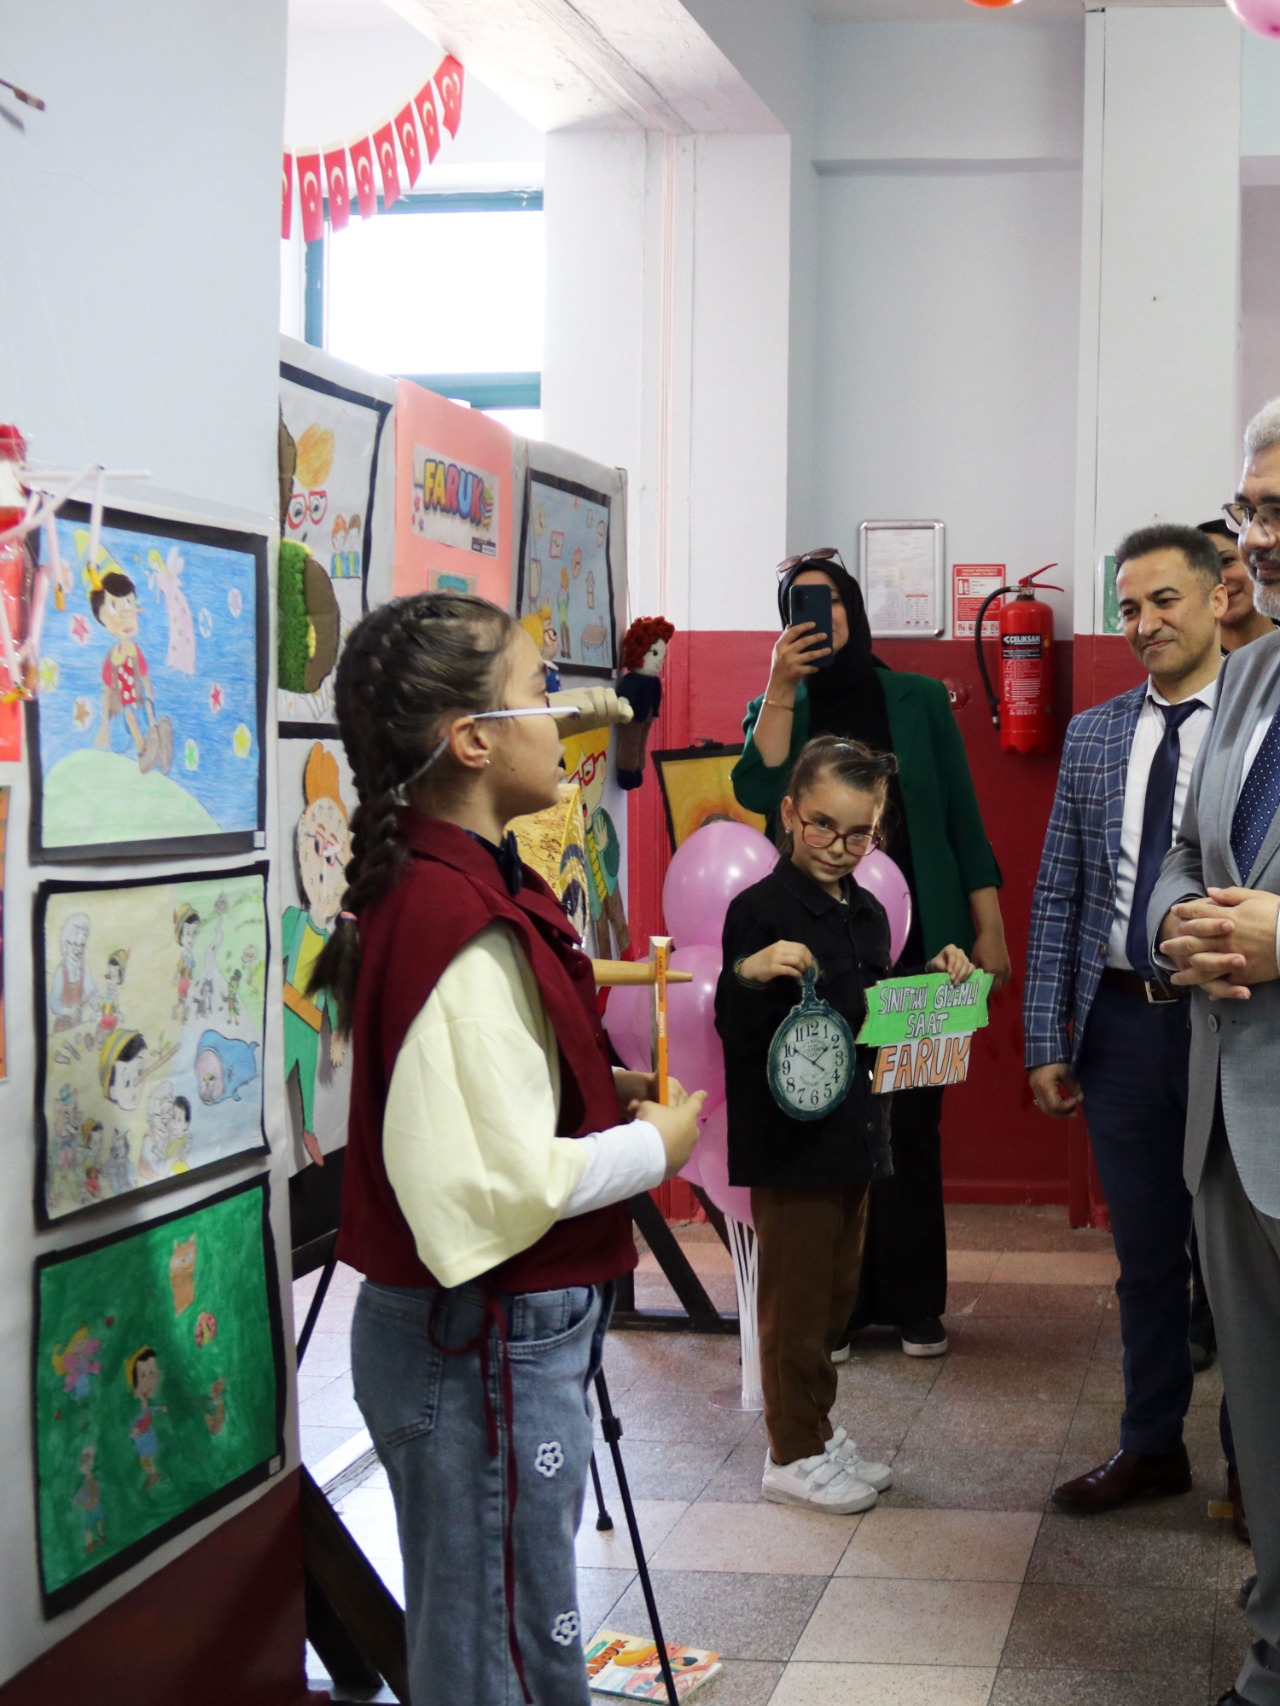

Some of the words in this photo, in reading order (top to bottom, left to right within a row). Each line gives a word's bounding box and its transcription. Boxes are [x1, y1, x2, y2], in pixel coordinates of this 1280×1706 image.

[424, 458, 484, 526] FARUK
[934, 978, 979, 1009] GİZEMLİ
[806, 1020, 819, 1037] 12
[823, 1023, 829, 1039] 1
[905, 1011, 949, 1038] SAAT
[795, 1026, 804, 1042] 11
[831, 1033, 840, 1050] 2
[784, 1042, 796, 1058] 10
[835, 1050, 844, 1067] 3
[782, 1060, 791, 1075] 9
[873, 1036, 972, 1094] FARUK
[786, 1076, 796, 1093] 8
[831, 1068, 841, 1084] 4
[797, 1087, 806, 1104] 7
[810, 1089, 819, 1105] 6
[823, 1083, 832, 1098] 5
